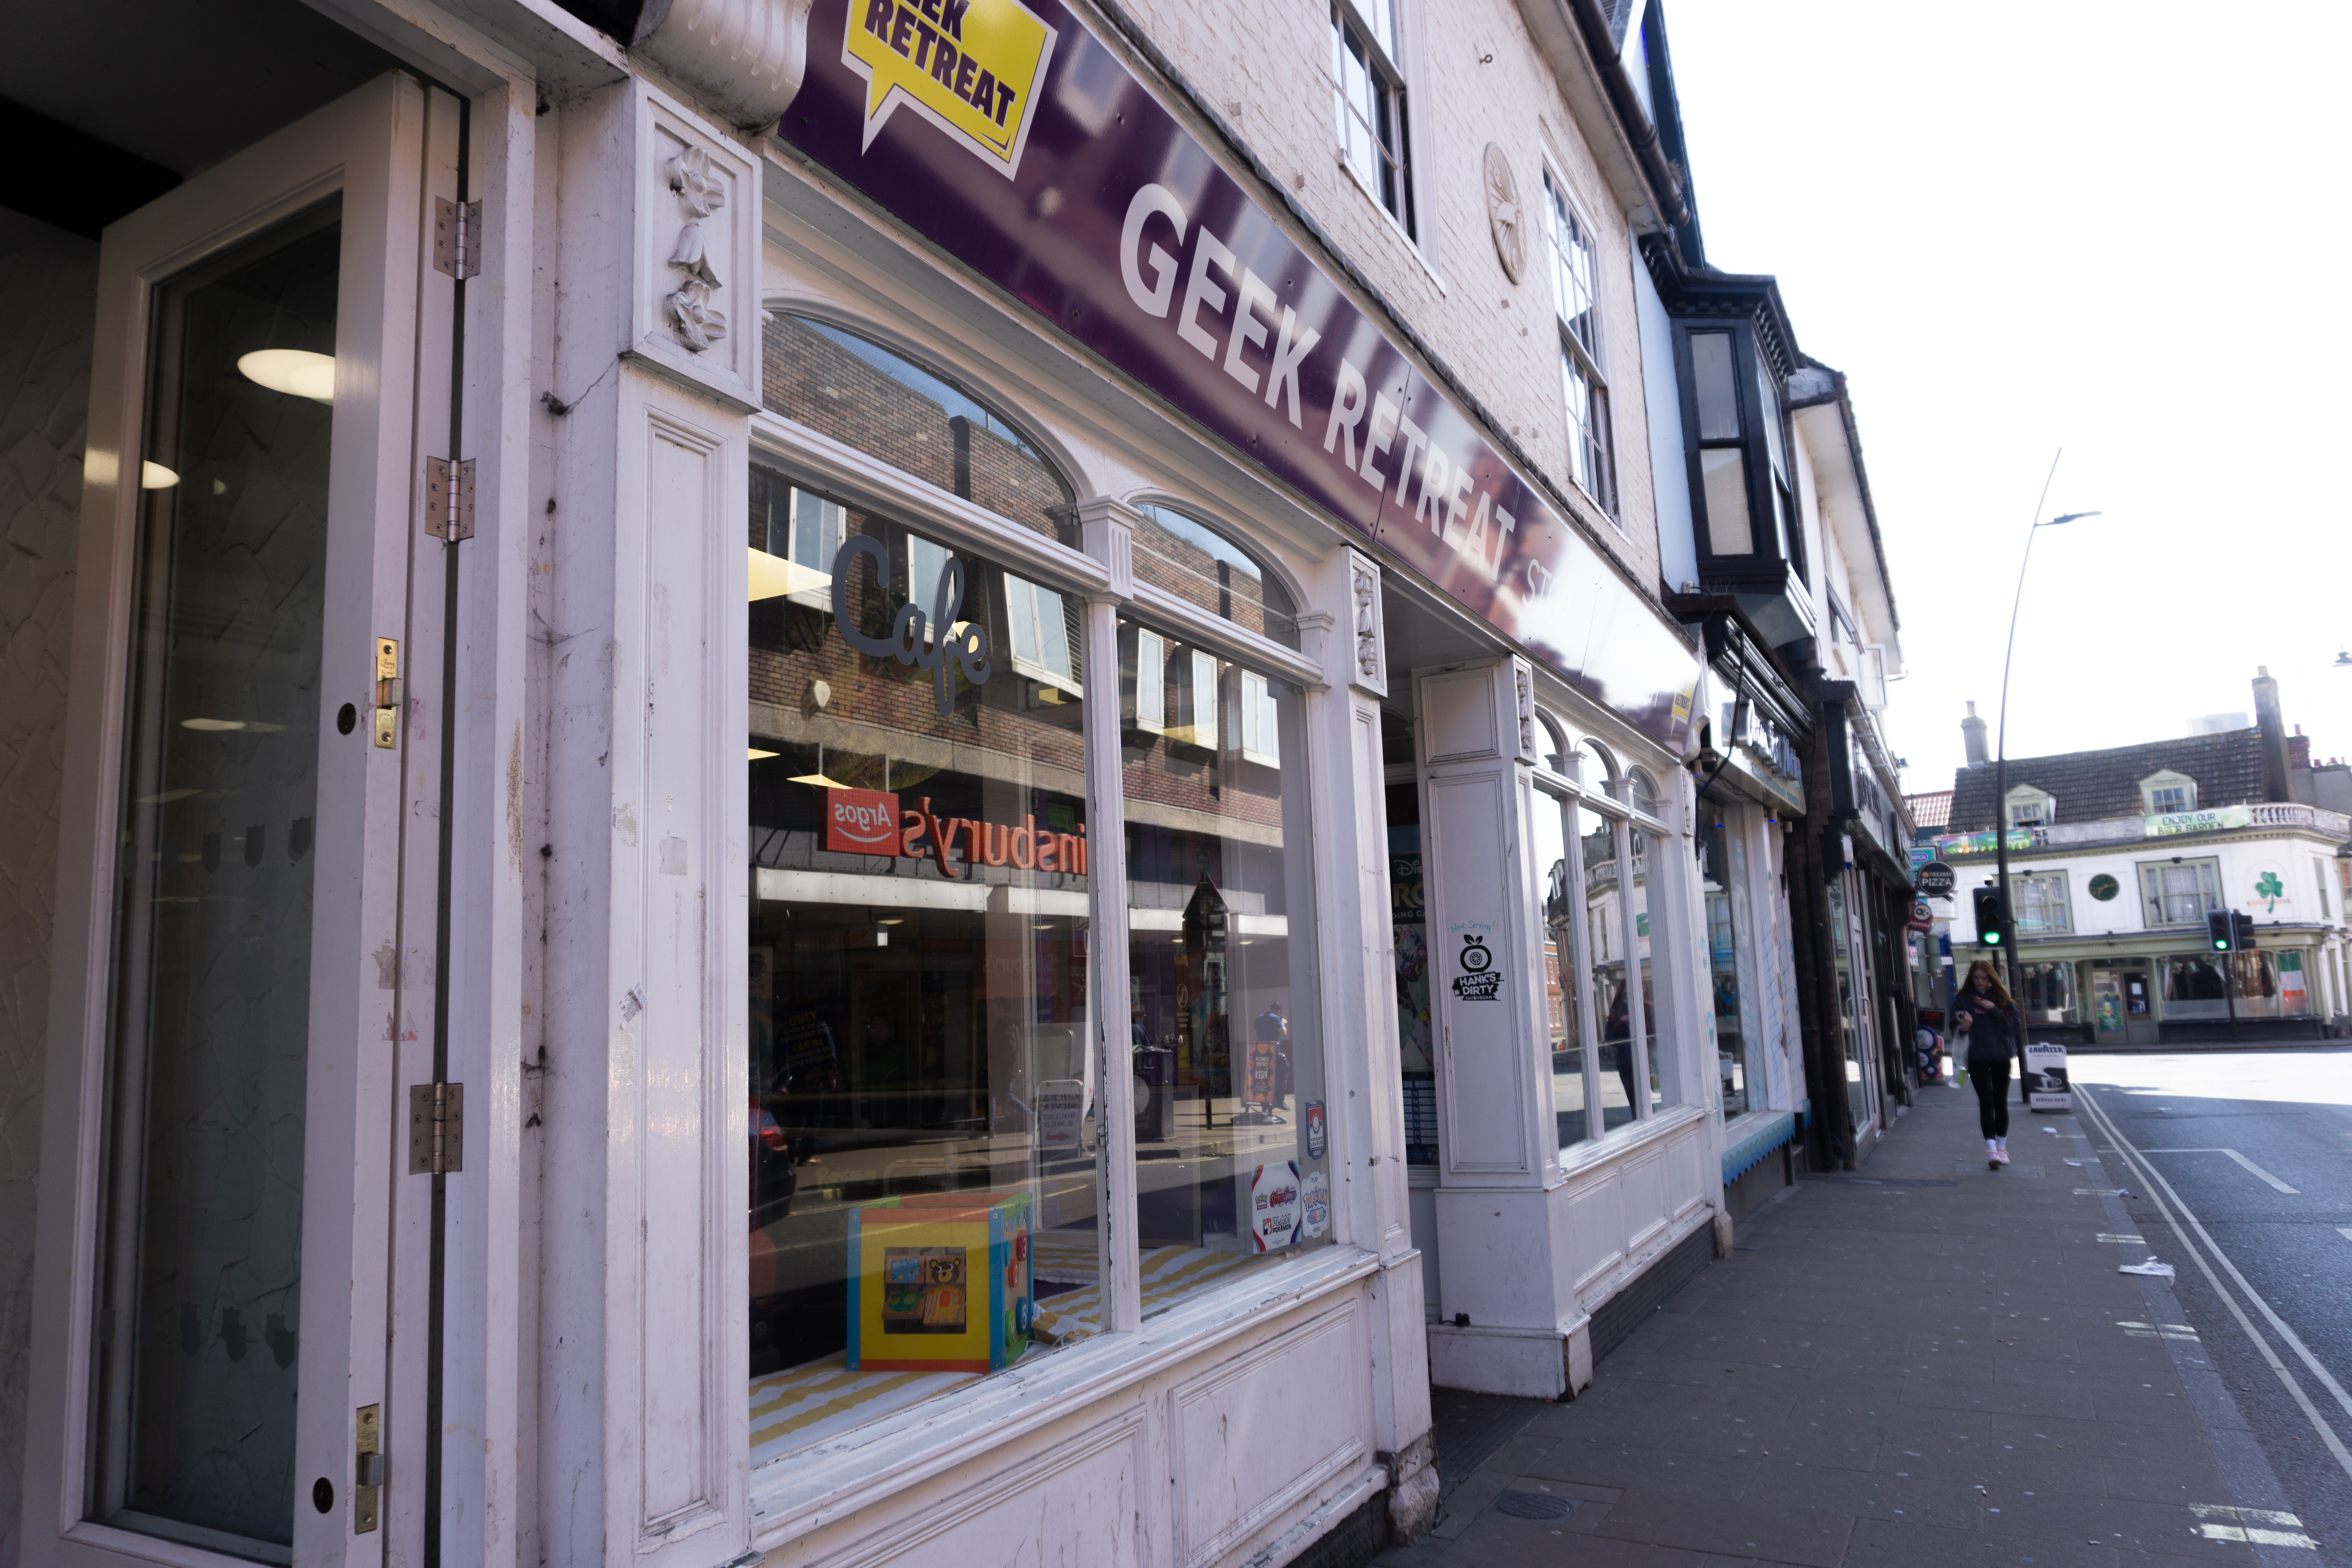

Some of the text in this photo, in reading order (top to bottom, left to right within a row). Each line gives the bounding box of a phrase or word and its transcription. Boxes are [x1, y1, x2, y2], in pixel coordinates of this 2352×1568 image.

[864, 0, 1016, 129] RETREAT
[1120, 183, 1515, 581] GEEK RETREAT
[831, 535, 991, 717] Cafe
[1675, 692, 1690, 711] RETREAT
[2163, 813, 2216, 826] ENJOY OUR
[2158, 821, 2224, 835] BEER GARDEN
[1392, 911, 1413, 919] DING
[1451, 920, 1496, 934] Now Serving!
[2085, 945, 2136, 954] shamrock
[1459, 973, 1496, 986] HANK'S
[1462, 984, 1494, 995] DIRTY
[788, 1010, 817, 1027] ONLY
[780, 1030, 815, 1044] PURCHASED
[783, 1027, 800, 1035] FOOD
[792, 1037, 824, 1053] CAN BE
[2029, 1045, 2063, 1053] LAVAZZA
[787, 1048, 822, 1061] CONSUMED
[788, 1052, 833, 1068] HESE PREMISE
[1272, 1213, 1291, 1227] PLAY!
[1272, 1223, 1292, 1234] POKÉMON
[1023, 1237, 1027, 1258] 3
[1014, 1264, 1018, 1284] 2
[1022, 1304, 1027, 1330] 5
[1010, 1318, 1014, 1340] 4
